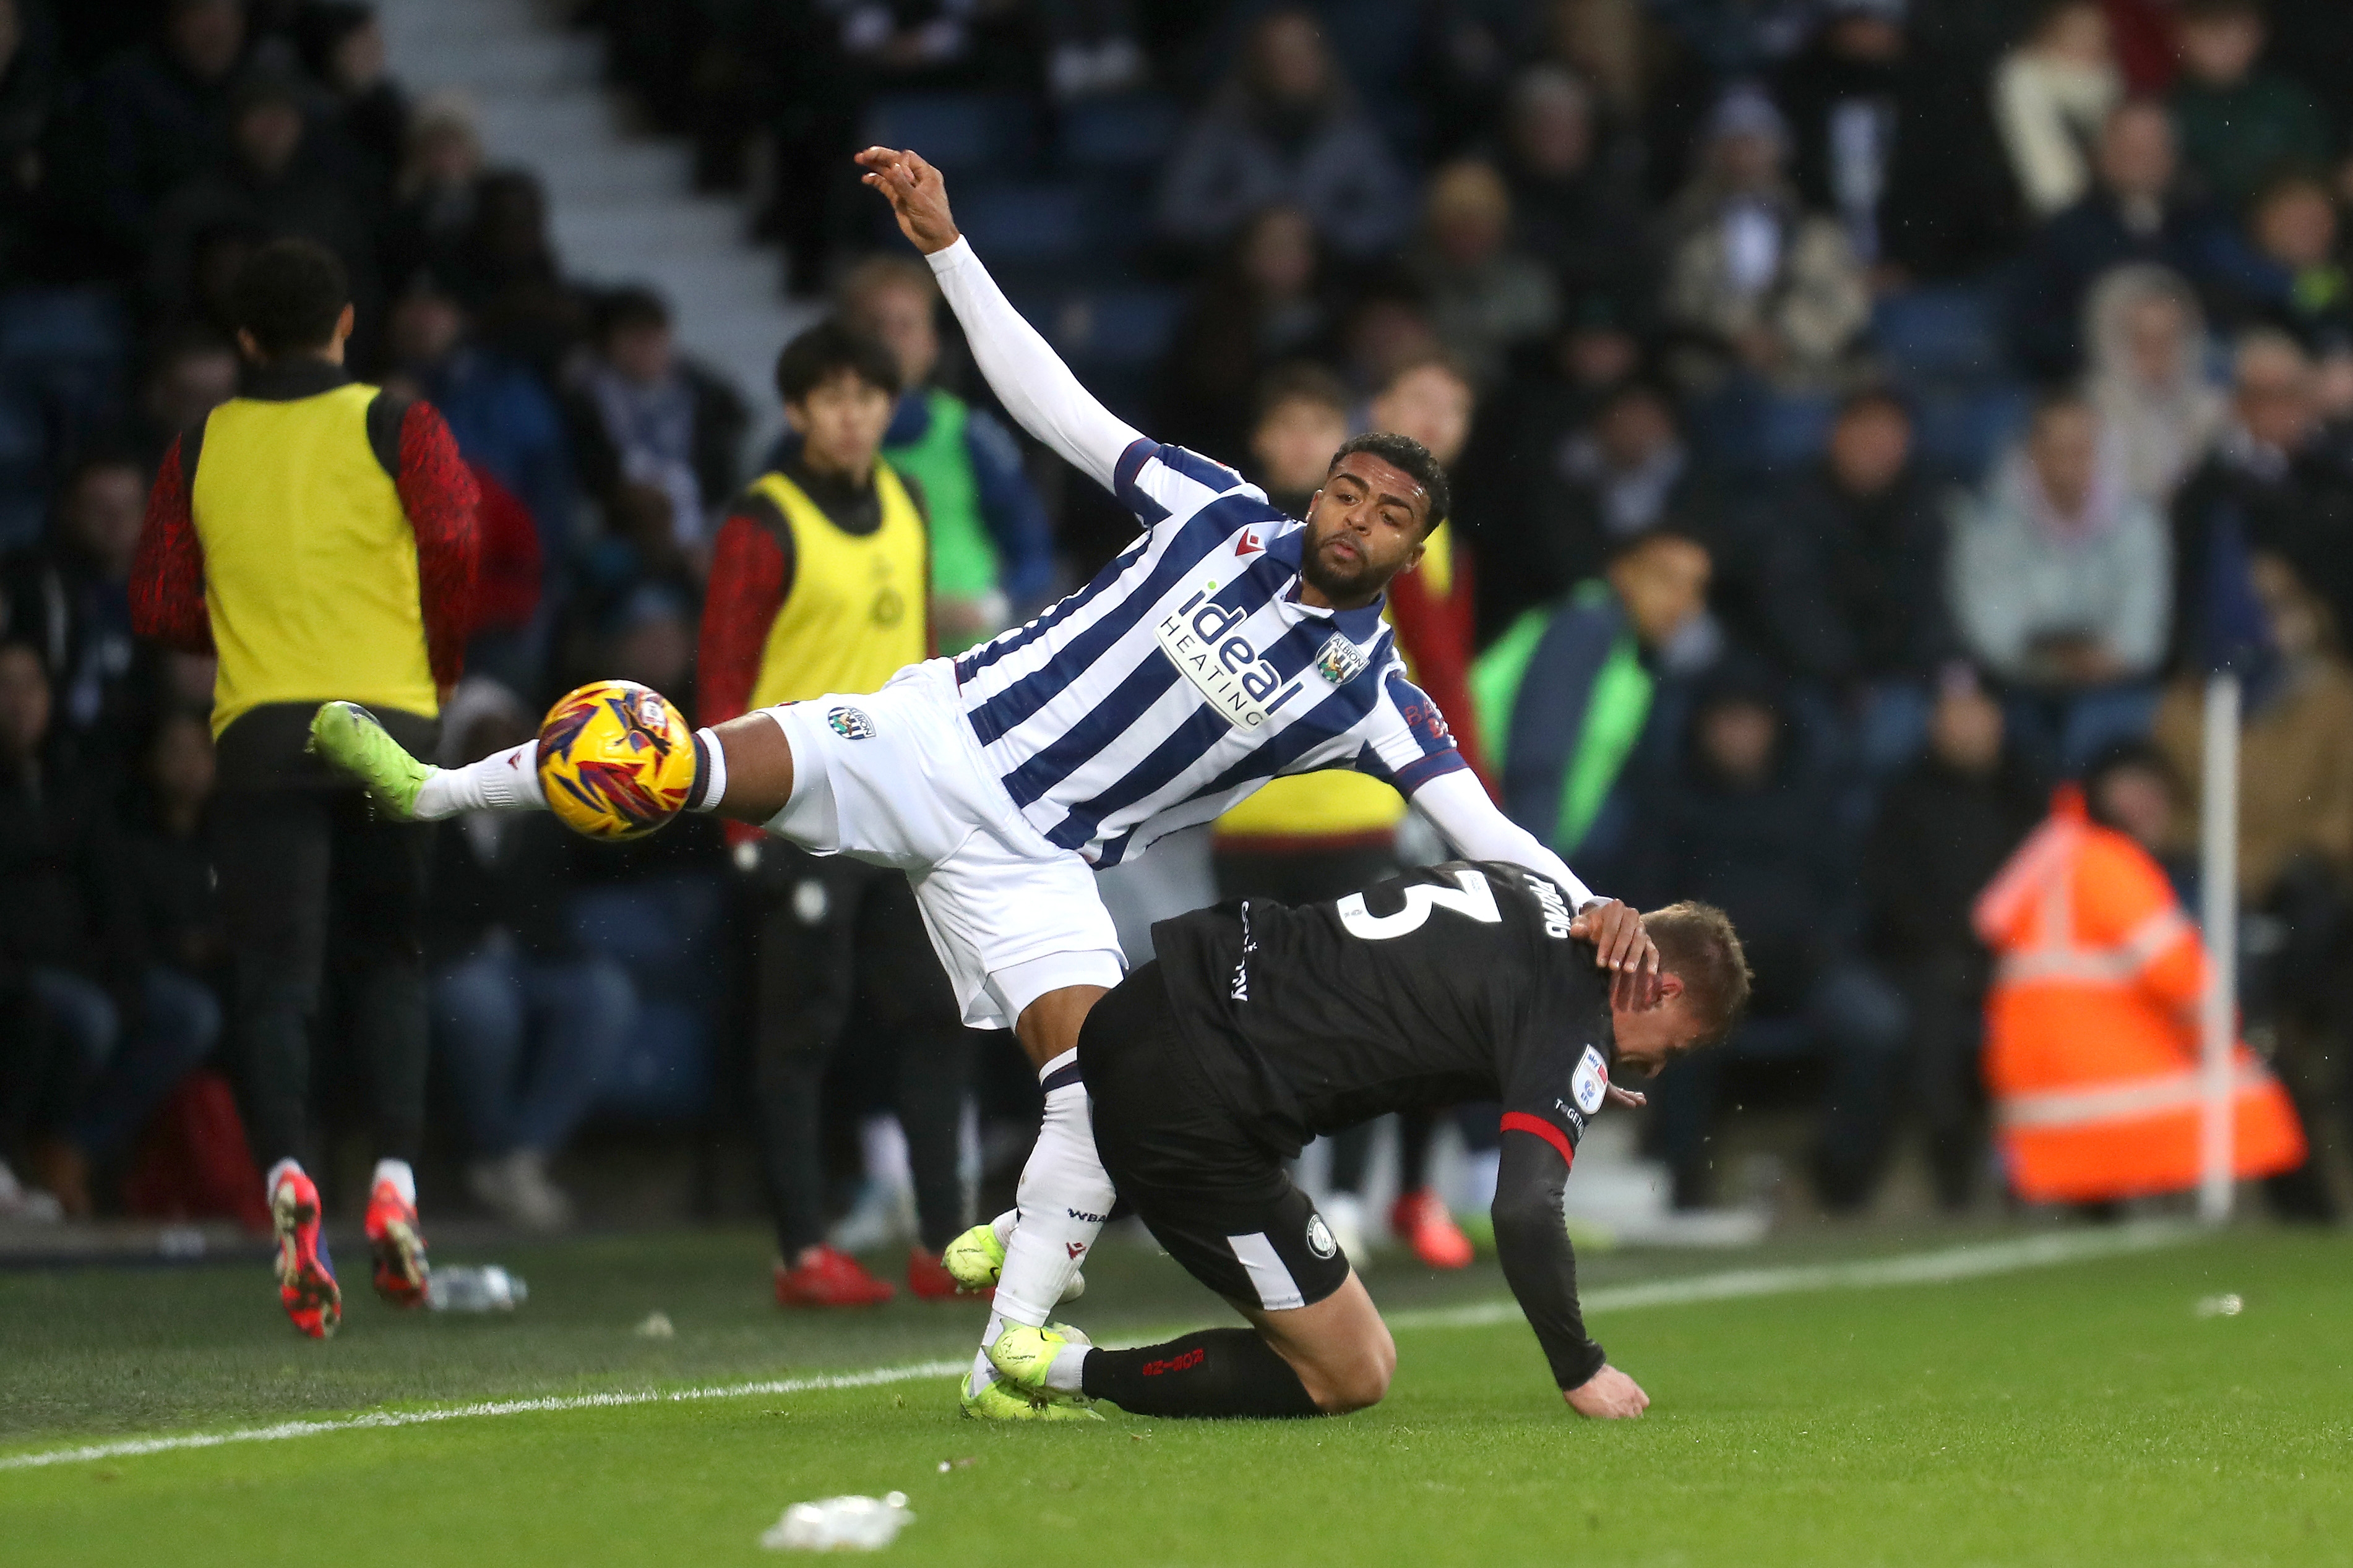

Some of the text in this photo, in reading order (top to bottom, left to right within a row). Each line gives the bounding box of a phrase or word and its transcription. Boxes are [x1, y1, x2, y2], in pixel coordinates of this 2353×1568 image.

[1160, 616, 1263, 726] HEATING
[1179, 581, 1304, 716] ideal
[1332, 638, 1364, 667] ALBION
[1336, 870, 1503, 940] 3
[1067, 1207, 1107, 1222] WBA
